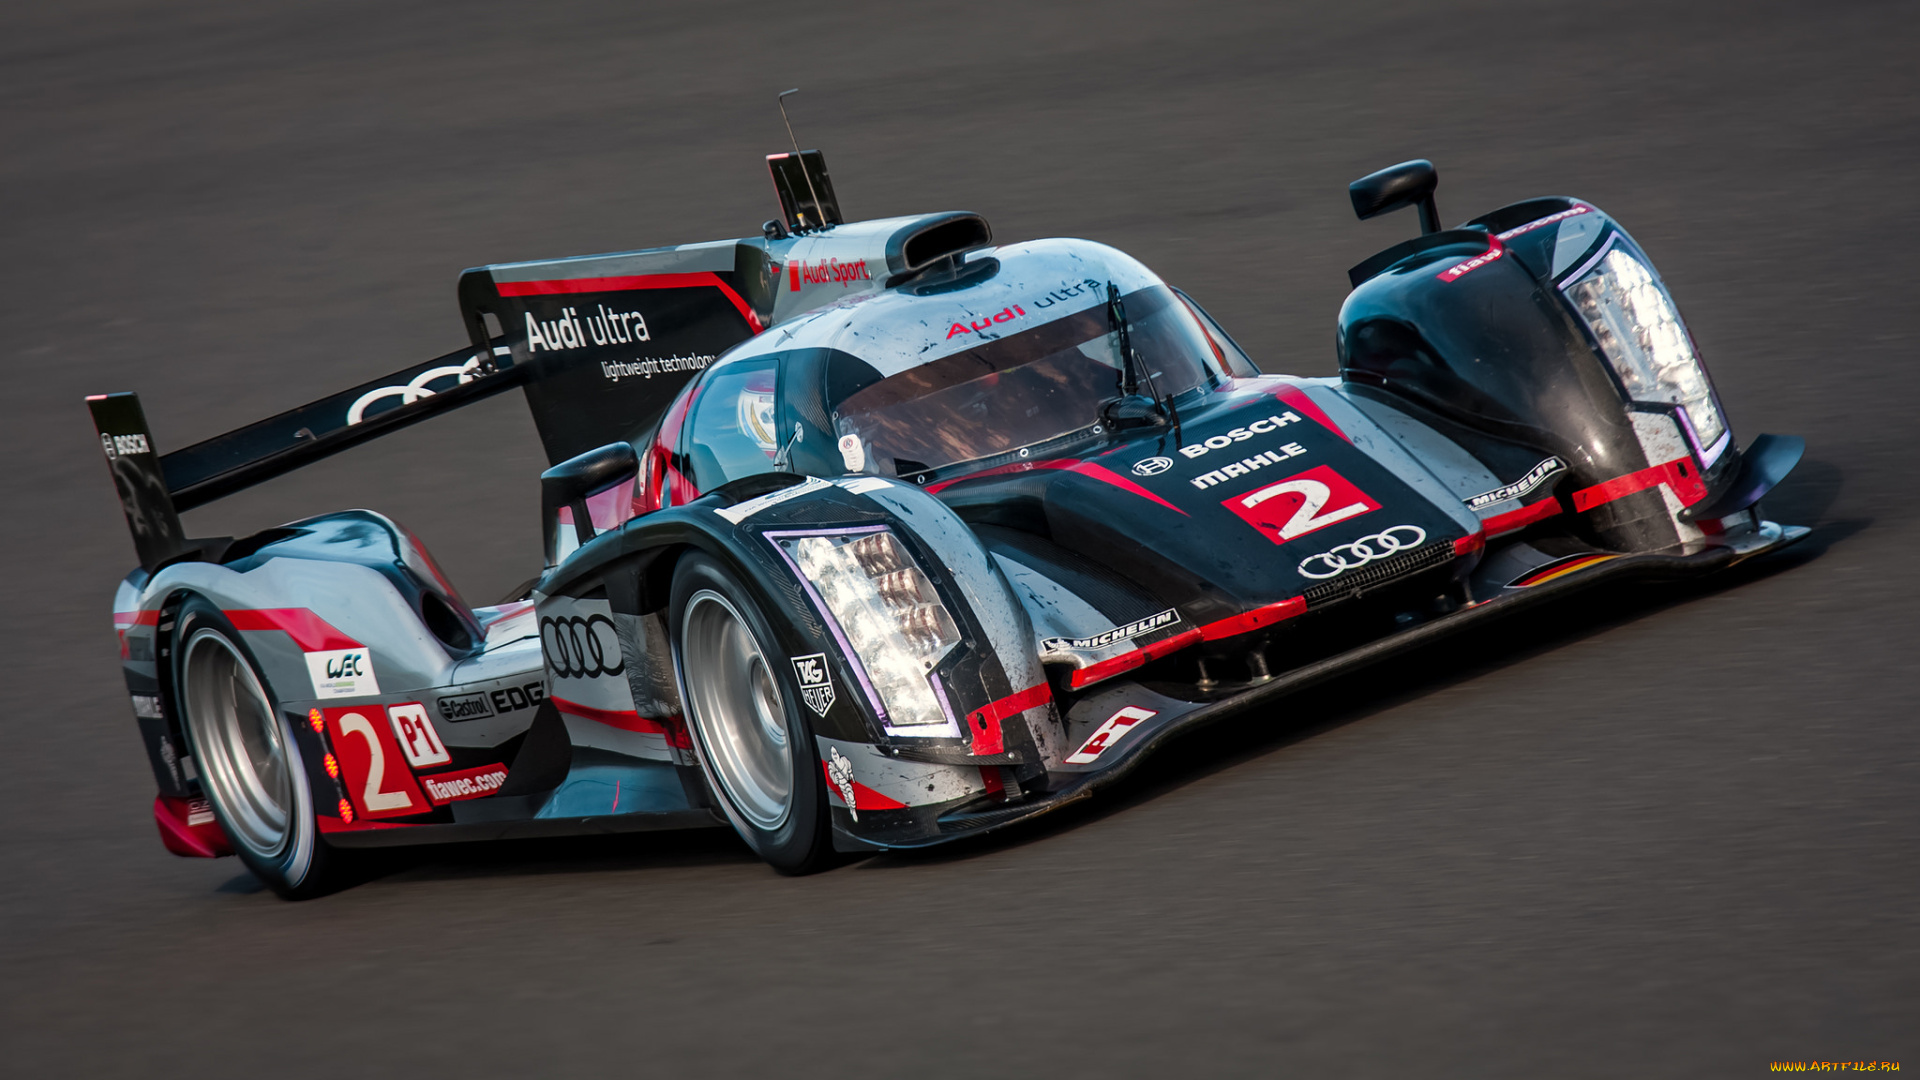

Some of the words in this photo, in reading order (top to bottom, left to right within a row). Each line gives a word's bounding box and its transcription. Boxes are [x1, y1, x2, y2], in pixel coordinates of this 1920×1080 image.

[803, 258, 831, 285] Audi
[830, 257, 870, 289] Sport
[525, 306, 587, 353] Audi
[586, 303, 651, 346] ultra
[946, 303, 1027, 340] Audi
[1033, 278, 1102, 310] ultra
[600, 356, 661, 382] lightweight
[1178, 411, 1303, 459] BOSCH
[1190, 441, 1308, 490] MAHLE
[1471, 459, 1558, 506] MICHELIN
[1240, 478, 1370, 541] 2
[1072, 611, 1172, 648] MICHELIN
[326, 653, 364, 679] WEC
[796, 658, 824, 685] TAG
[450, 696, 489, 718] Castrol
[490, 680, 545, 714] EDG
[803, 686, 833, 713] HEUER
[397, 713, 440, 758] P1
[1080, 715, 1141, 755] P1
[338, 712, 414, 812] 2
[425, 771, 508, 800] fiawec.com
